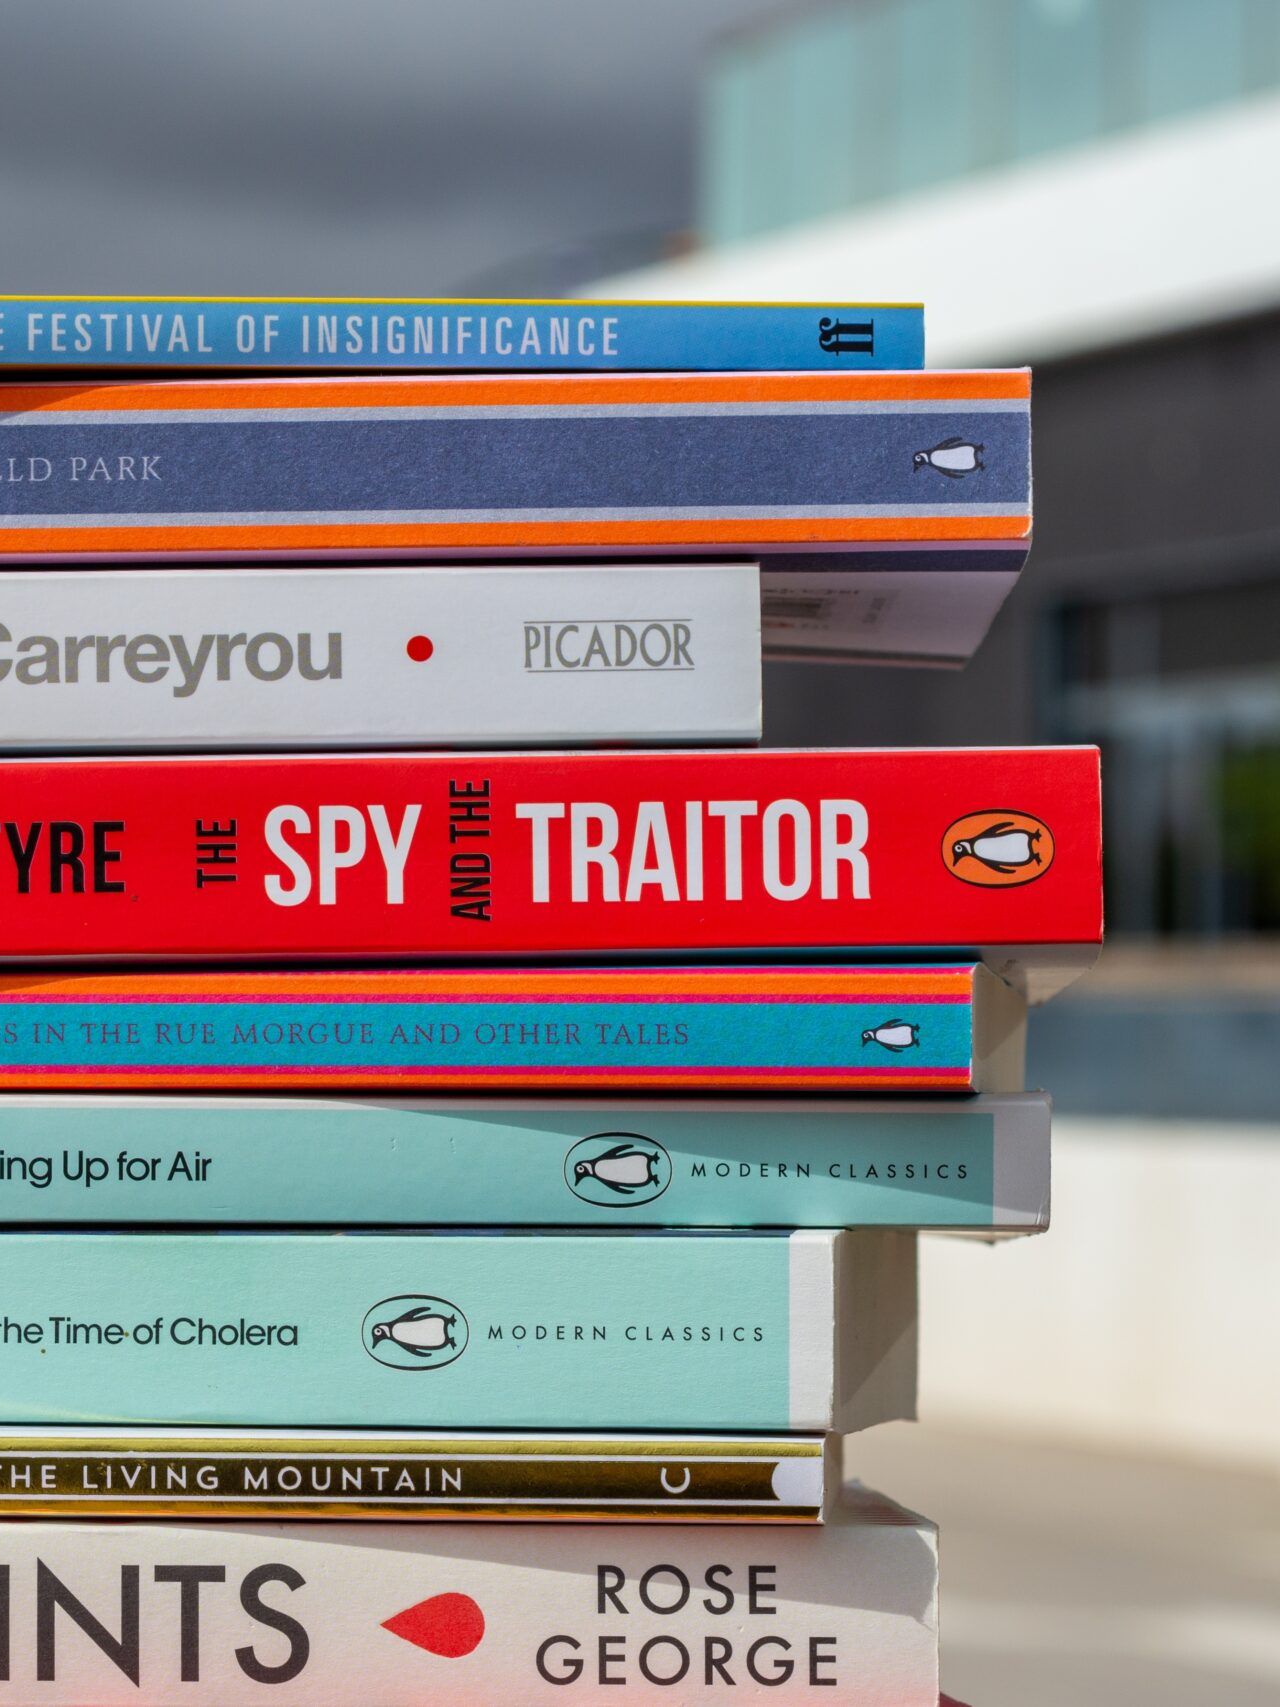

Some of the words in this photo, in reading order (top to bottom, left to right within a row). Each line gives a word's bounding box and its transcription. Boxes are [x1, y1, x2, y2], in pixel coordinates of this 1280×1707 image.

[27, 313, 212, 353] FESTIVAL
[236, 314, 279, 353] OF
[302, 314, 619, 356] INSIGNIFICANCE
[69, 455, 162, 482] PARK
[523, 623, 695, 669] PICADOR
[449, 780, 490, 843] THE
[196, 819, 237, 889] THE
[264, 804, 422, 907] SPY
[515, 799, 871, 903] TRAITOR
[450, 853, 491, 921] AND
[32, 1022, 66, 1045] IN
[80, 1022, 141, 1045] THE
[154, 1022, 216, 1045] RUE
[230, 1022, 375, 1045] MORGUE
[389, 1022, 461, 1045] AND
[474, 1022, 581, 1045] OTHER
[594, 1022, 689, 1045] TALES
[62, 1150, 110, 1188] Up
[116, 1150, 162, 1182] for
[167, 1150, 212, 1182] Air
[690, 1162, 811, 1178] MODERN
[828, 1163, 968, 1180] CLASSICS
[48, 1316, 125, 1345] Time
[132, 1317, 164, 1345] of
[169, 1317, 298, 1347] Cholera
[487, 1325, 606, 1341] MODERN
[624, 1326, 763, 1342] CLASSICS
[81, 1464, 220, 1490] LIVING
[242, 1465, 463, 1492] MOUNTAIN
[597, 1563, 777, 1615] ROSE
[535, 1634, 838, 1687] GEORGE
